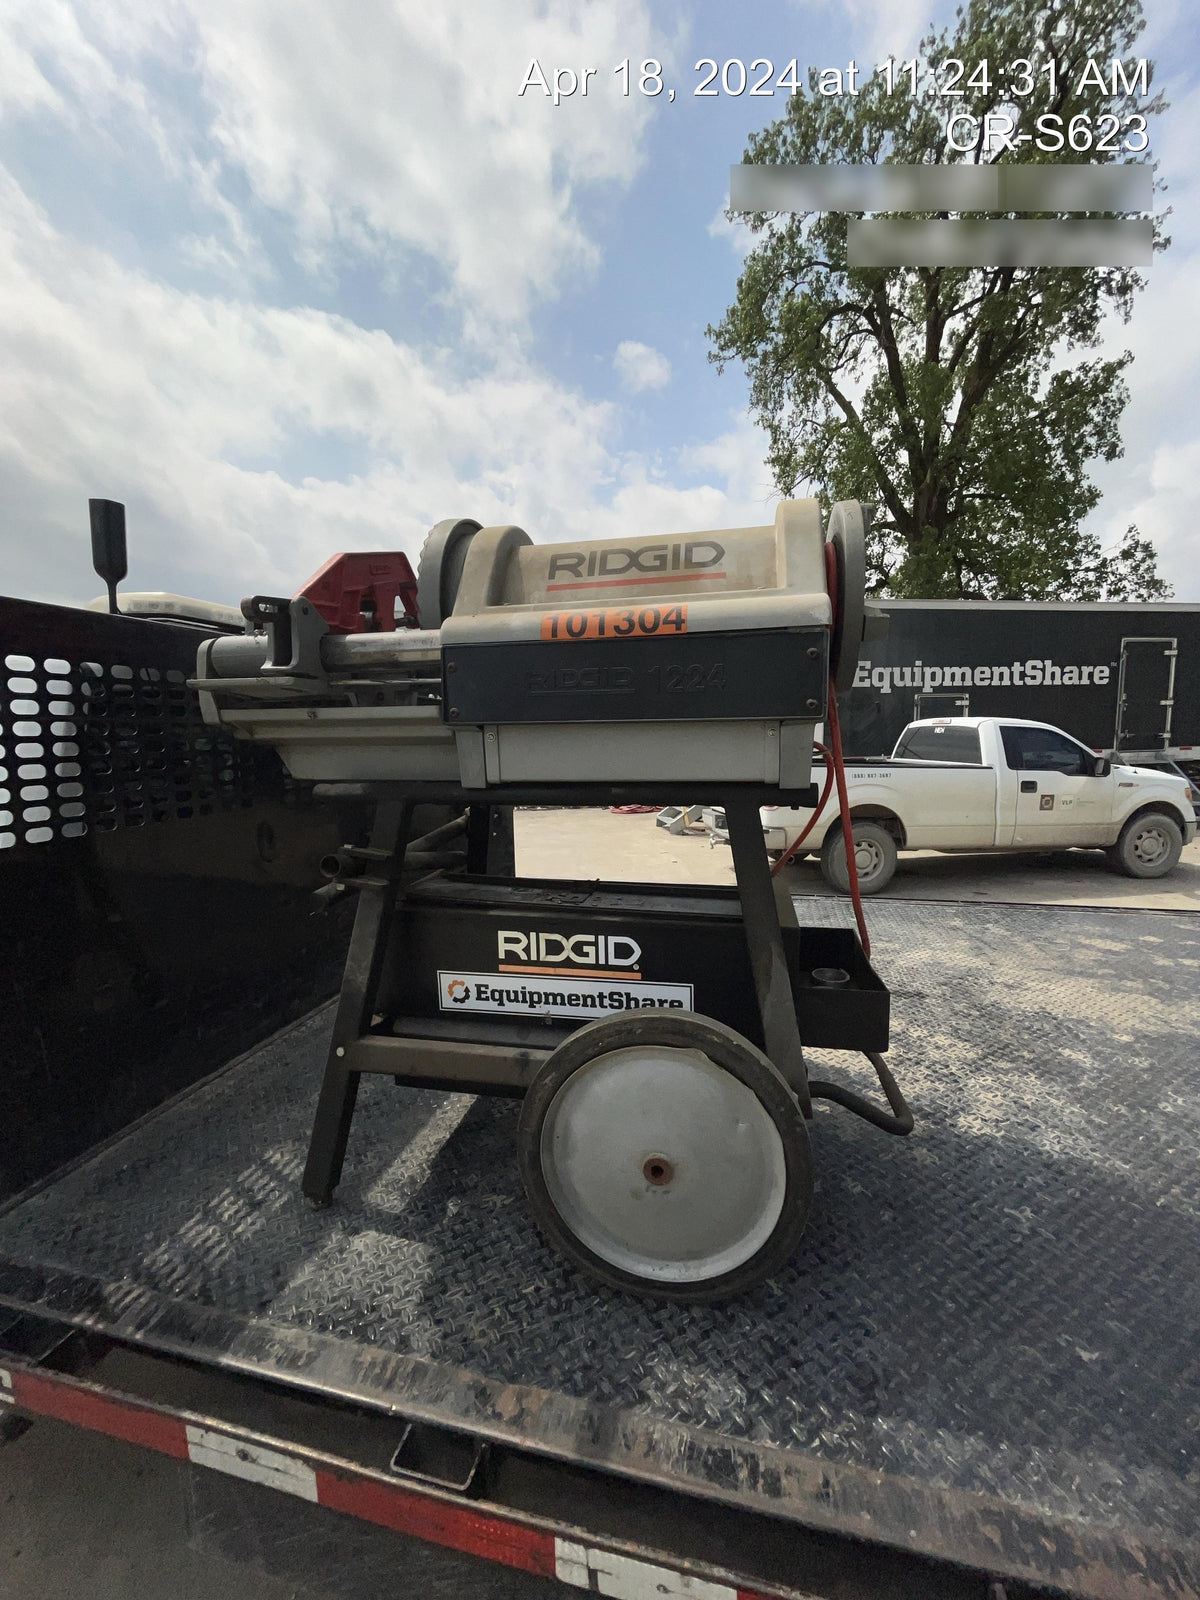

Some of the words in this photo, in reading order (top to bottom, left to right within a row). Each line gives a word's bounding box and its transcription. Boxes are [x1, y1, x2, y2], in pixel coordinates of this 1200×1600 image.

[548, 540, 726, 580] RIDGID
[546, 605, 686, 639] 101304
[648, 663, 727, 692] 1224
[851, 659, 1110, 694] EquipmentShare
[497, 930, 642, 966] RIDGID
[474, 983, 684, 1010] EquipmentShare
